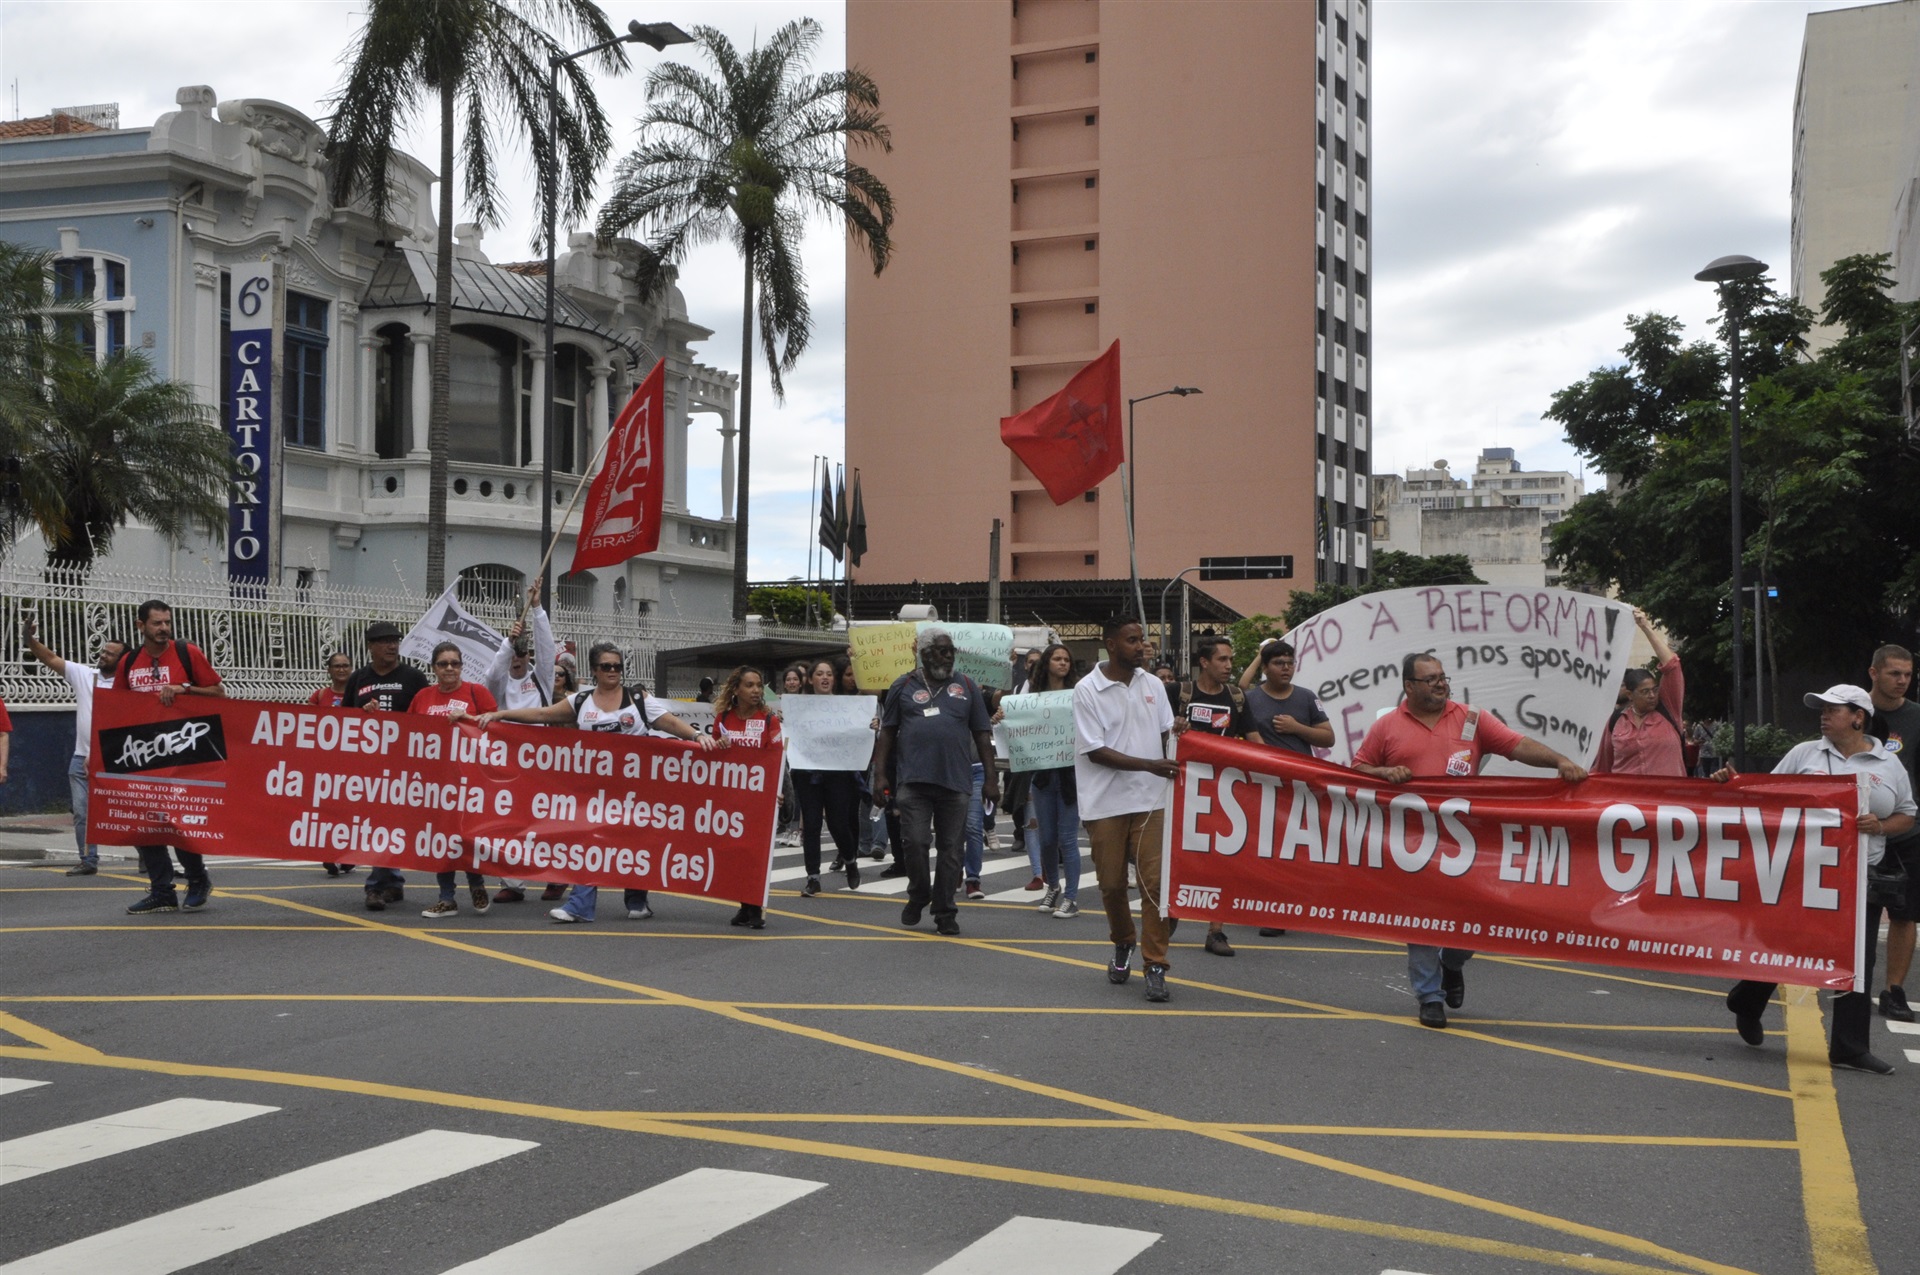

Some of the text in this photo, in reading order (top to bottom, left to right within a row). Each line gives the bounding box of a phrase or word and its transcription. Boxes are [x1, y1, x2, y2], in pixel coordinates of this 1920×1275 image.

[233, 340, 263, 561] CARTORIO
[590, 528, 643, 549] BRASIL
[1361, 601, 1399, 640] À
[1416, 588, 1620, 662] REFORMA!
[1457, 645, 1508, 669] nos
[449, 700, 467, 709] FORA
[1006, 695, 1039, 713] NÃO
[1192, 708, 1211, 718] FORA
[583, 711, 599, 720] FORA
[747, 720, 764, 728] FORA
[1007, 723, 1050, 740] DINHEIRO
[114, 721, 211, 768] APEOESP
[251, 710, 765, 792] APEOESP na luta contra a reforma
[1448, 760, 1469, 773] FORA
[93, 788, 145, 799] PROFESSORES
[157, 793, 189, 803] ENSINO
[189, 797, 225, 806] OFICIAL
[127, 783, 188, 794] SINDICATO DOS
[107, 798, 208, 812] DO ESTADO DE SÃO PAULO
[265, 760, 745, 838] da previdência e em defesa dos
[108, 808, 138, 820] Filiado
[181, 815, 208, 825] CUT
[95, 822, 131, 832] APEOESP
[176, 829, 224, 839] CAMPINAS
[1181, 761, 1842, 911] ESTAMOS EM GREVE
[289, 811, 715, 892] direitos dos professores (as)
[1232, 898, 1303, 916] SINDICATO
[1309, 906, 1336, 920] DOS
[1342, 909, 1456, 932] TRABALHADORES
[1462, 922, 1482, 935] DO
[1488, 924, 1549, 944] SERVIÇO
[1555, 930, 1620, 950] PÚBLICO
[1627, 939, 1713, 960] MUNICIPAL
[1721, 948, 1742, 962] DE
[1749, 951, 1836, 973] CAMPINAS
